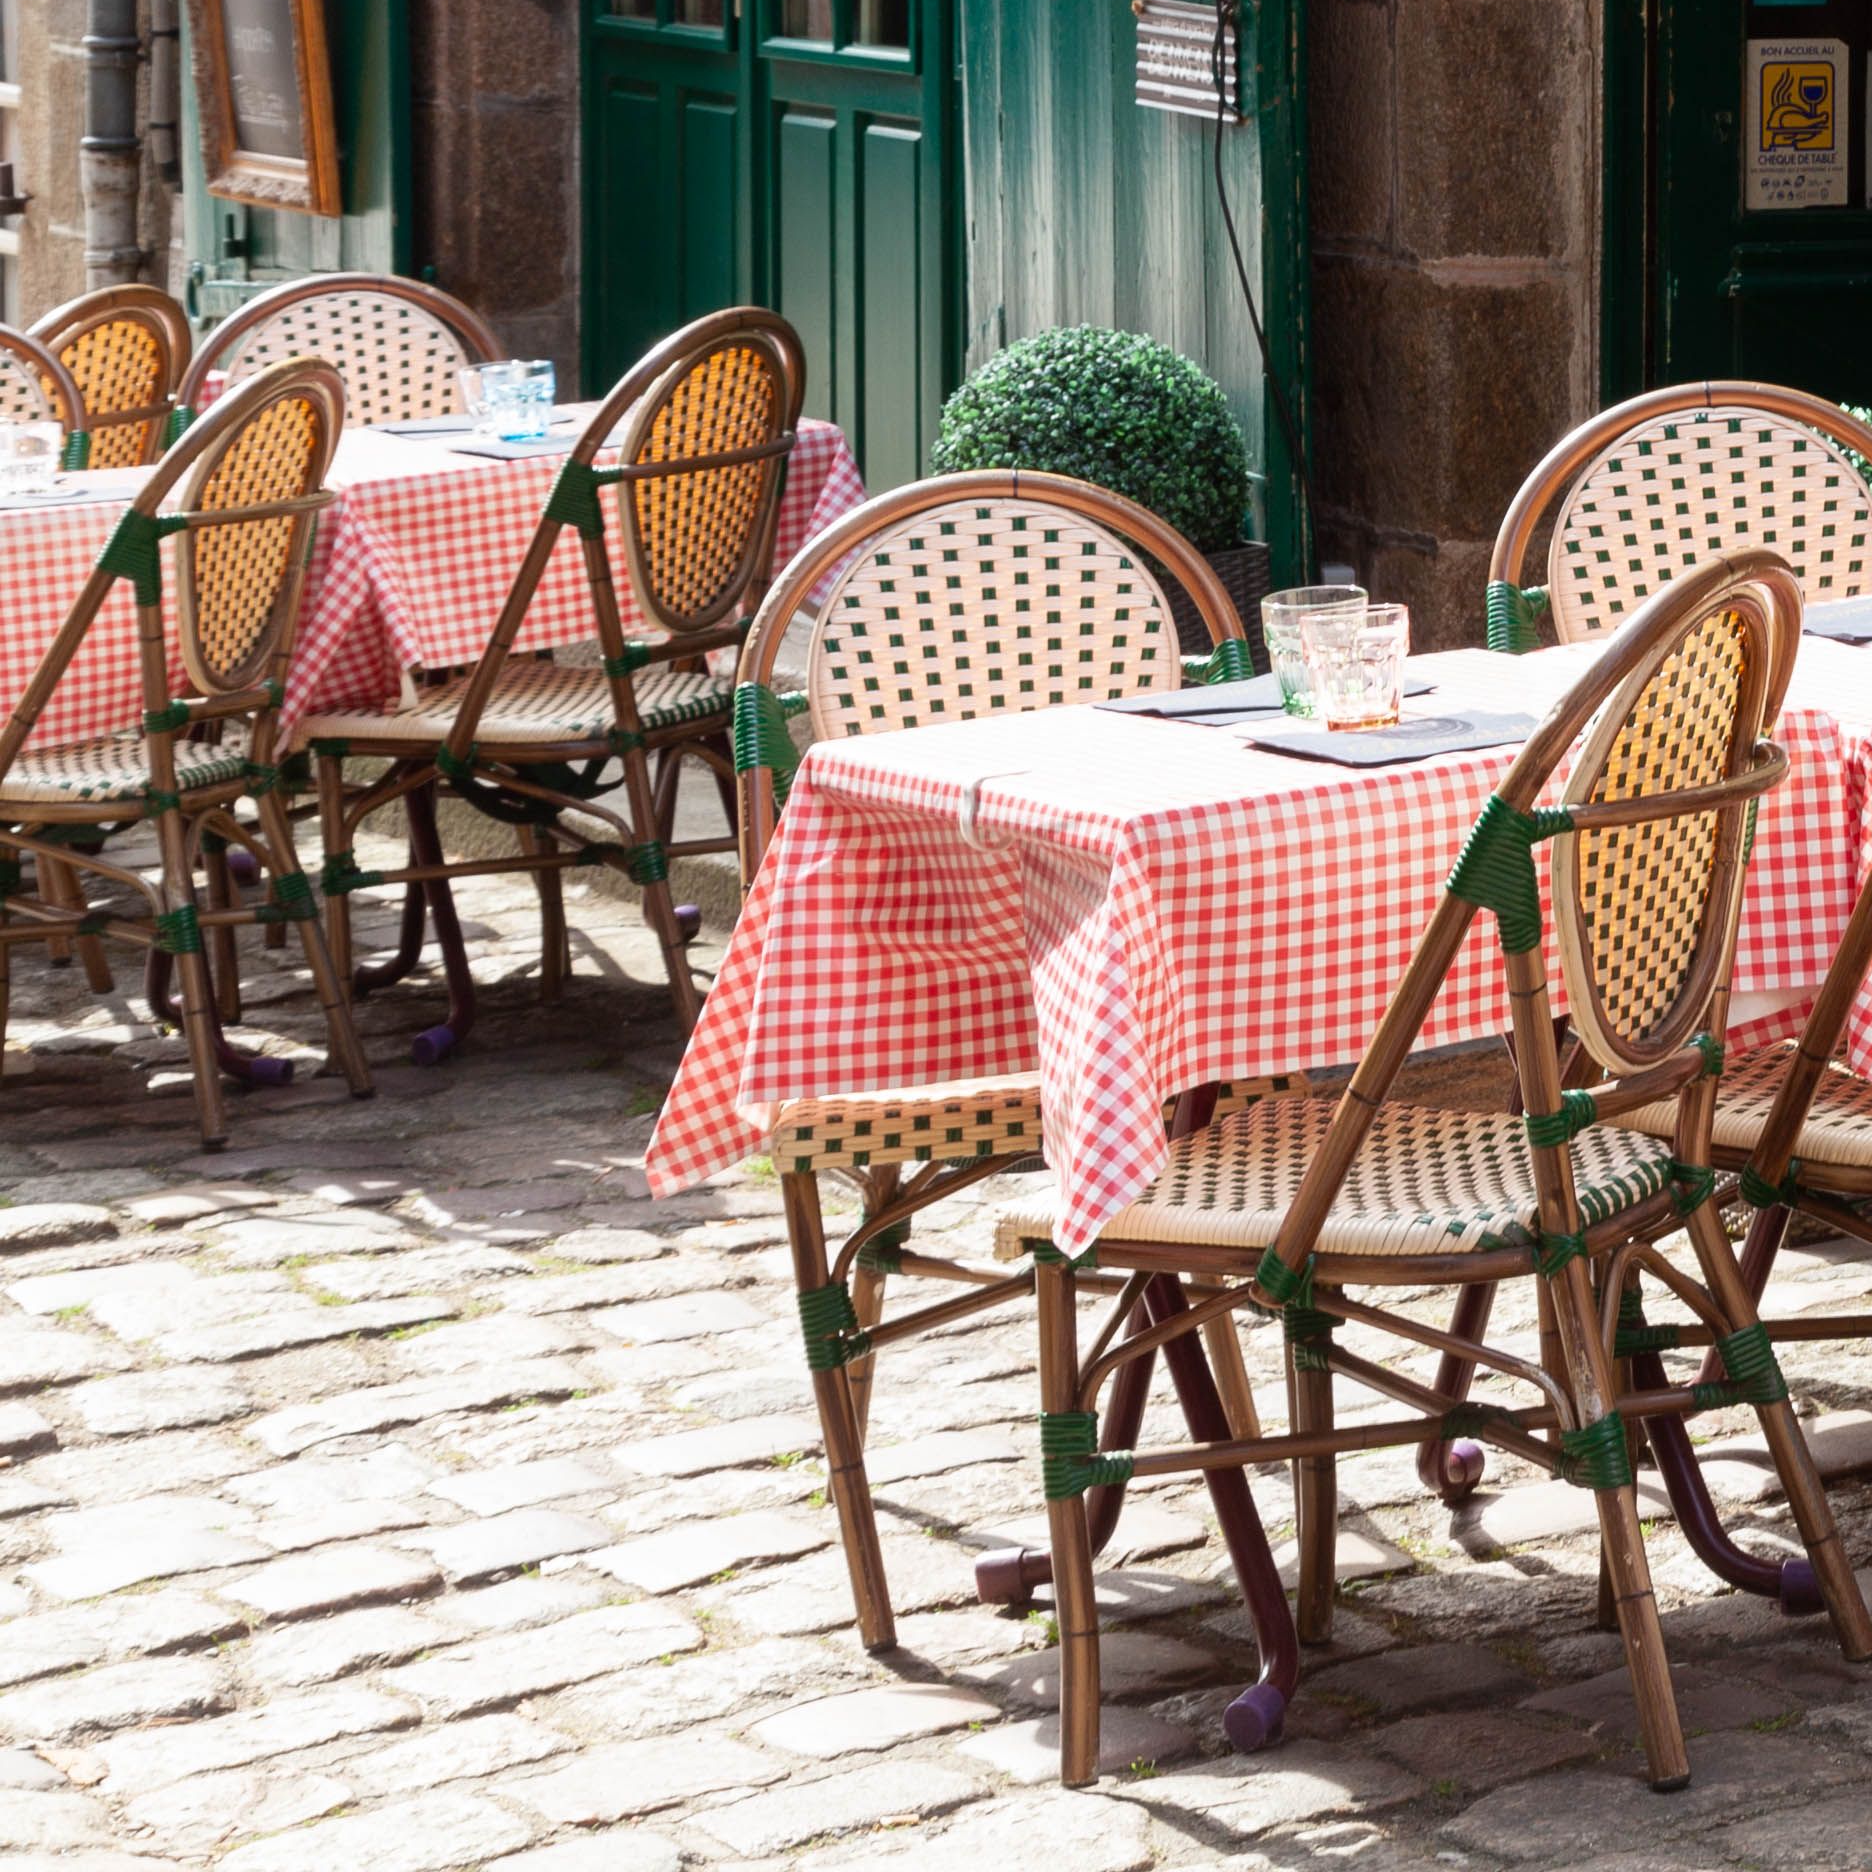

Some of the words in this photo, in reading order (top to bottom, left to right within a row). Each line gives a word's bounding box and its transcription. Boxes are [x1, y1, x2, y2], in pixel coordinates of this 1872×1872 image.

[1760, 47, 1782, 59] BON
[1783, 46, 1819, 58] ACCUEIL
[1822, 46, 1835, 56] AU
[1798, 154, 1809, 165] DE
[1811, 153, 1836, 164] TABLE
